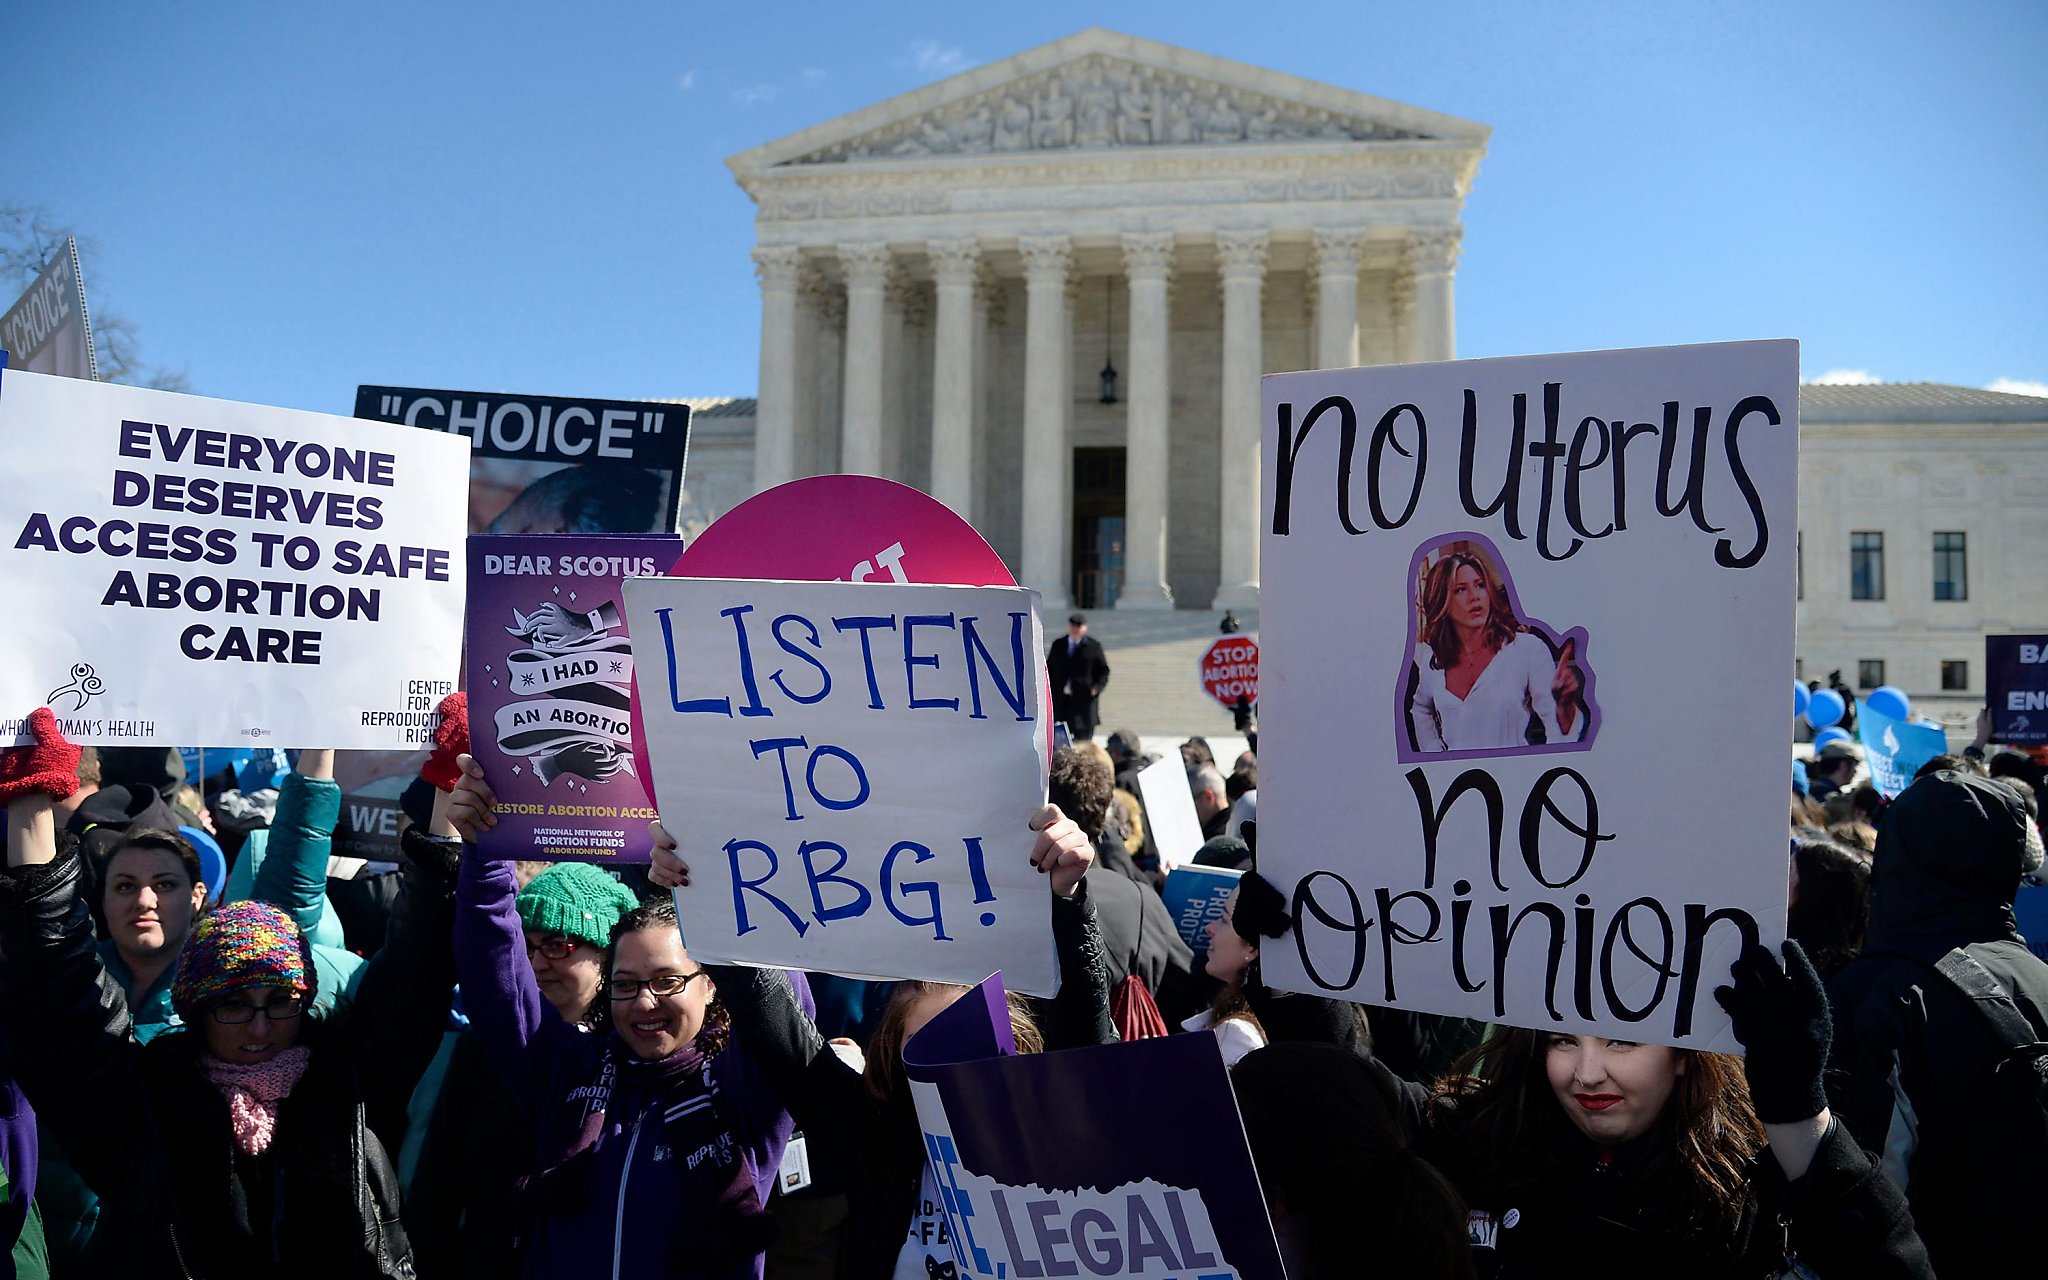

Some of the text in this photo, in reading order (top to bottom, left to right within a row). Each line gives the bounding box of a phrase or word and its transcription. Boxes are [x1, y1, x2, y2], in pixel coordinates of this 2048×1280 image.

[4, 257, 70, 361] "CHOICE"
[380, 395, 665, 459] "CHOICE"
[118, 419, 395, 487] EVERYONE
[1272, 395, 1427, 536] no
[112, 469, 384, 531] DESERVES
[14, 512, 450, 582] ACCESS TO SAFE
[484, 554, 664, 577] DEAR SCOTUS,
[100, 569, 381, 622] ABORTION
[180, 623, 322, 665] CARE
[1211, 645, 1256, 665] STOP
[541, 660, 599, 682] I HAD
[654, 605, 1036, 722] LISTEN
[1204, 662, 1258, 681] ABORTIO
[408, 680, 452, 695] CENTER
[1215, 681, 1258, 698] NOW
[407, 696, 431, 711] FOR
[0, 719, 155, 737] WHOL OMAN'S HEALTH
[361, 711, 443, 727] REPRODUCTI
[512, 708, 630, 736] AN ABORTIO
[406, 728, 436, 743] RIGH
[749, 735, 871, 821] TO
[548, 804, 618, 818] ABORTION
[533, 827, 625, 838] NATIONAL NETWORK OF
[1404, 766, 1617, 892] no
[533, 836, 626, 848] ABORTION FUNDS
[543, 847, 617, 856] @ABORTIONFUNDS
[722, 836, 998, 941] RBG!
[989, 1190, 1218, 1278] LEGAL
